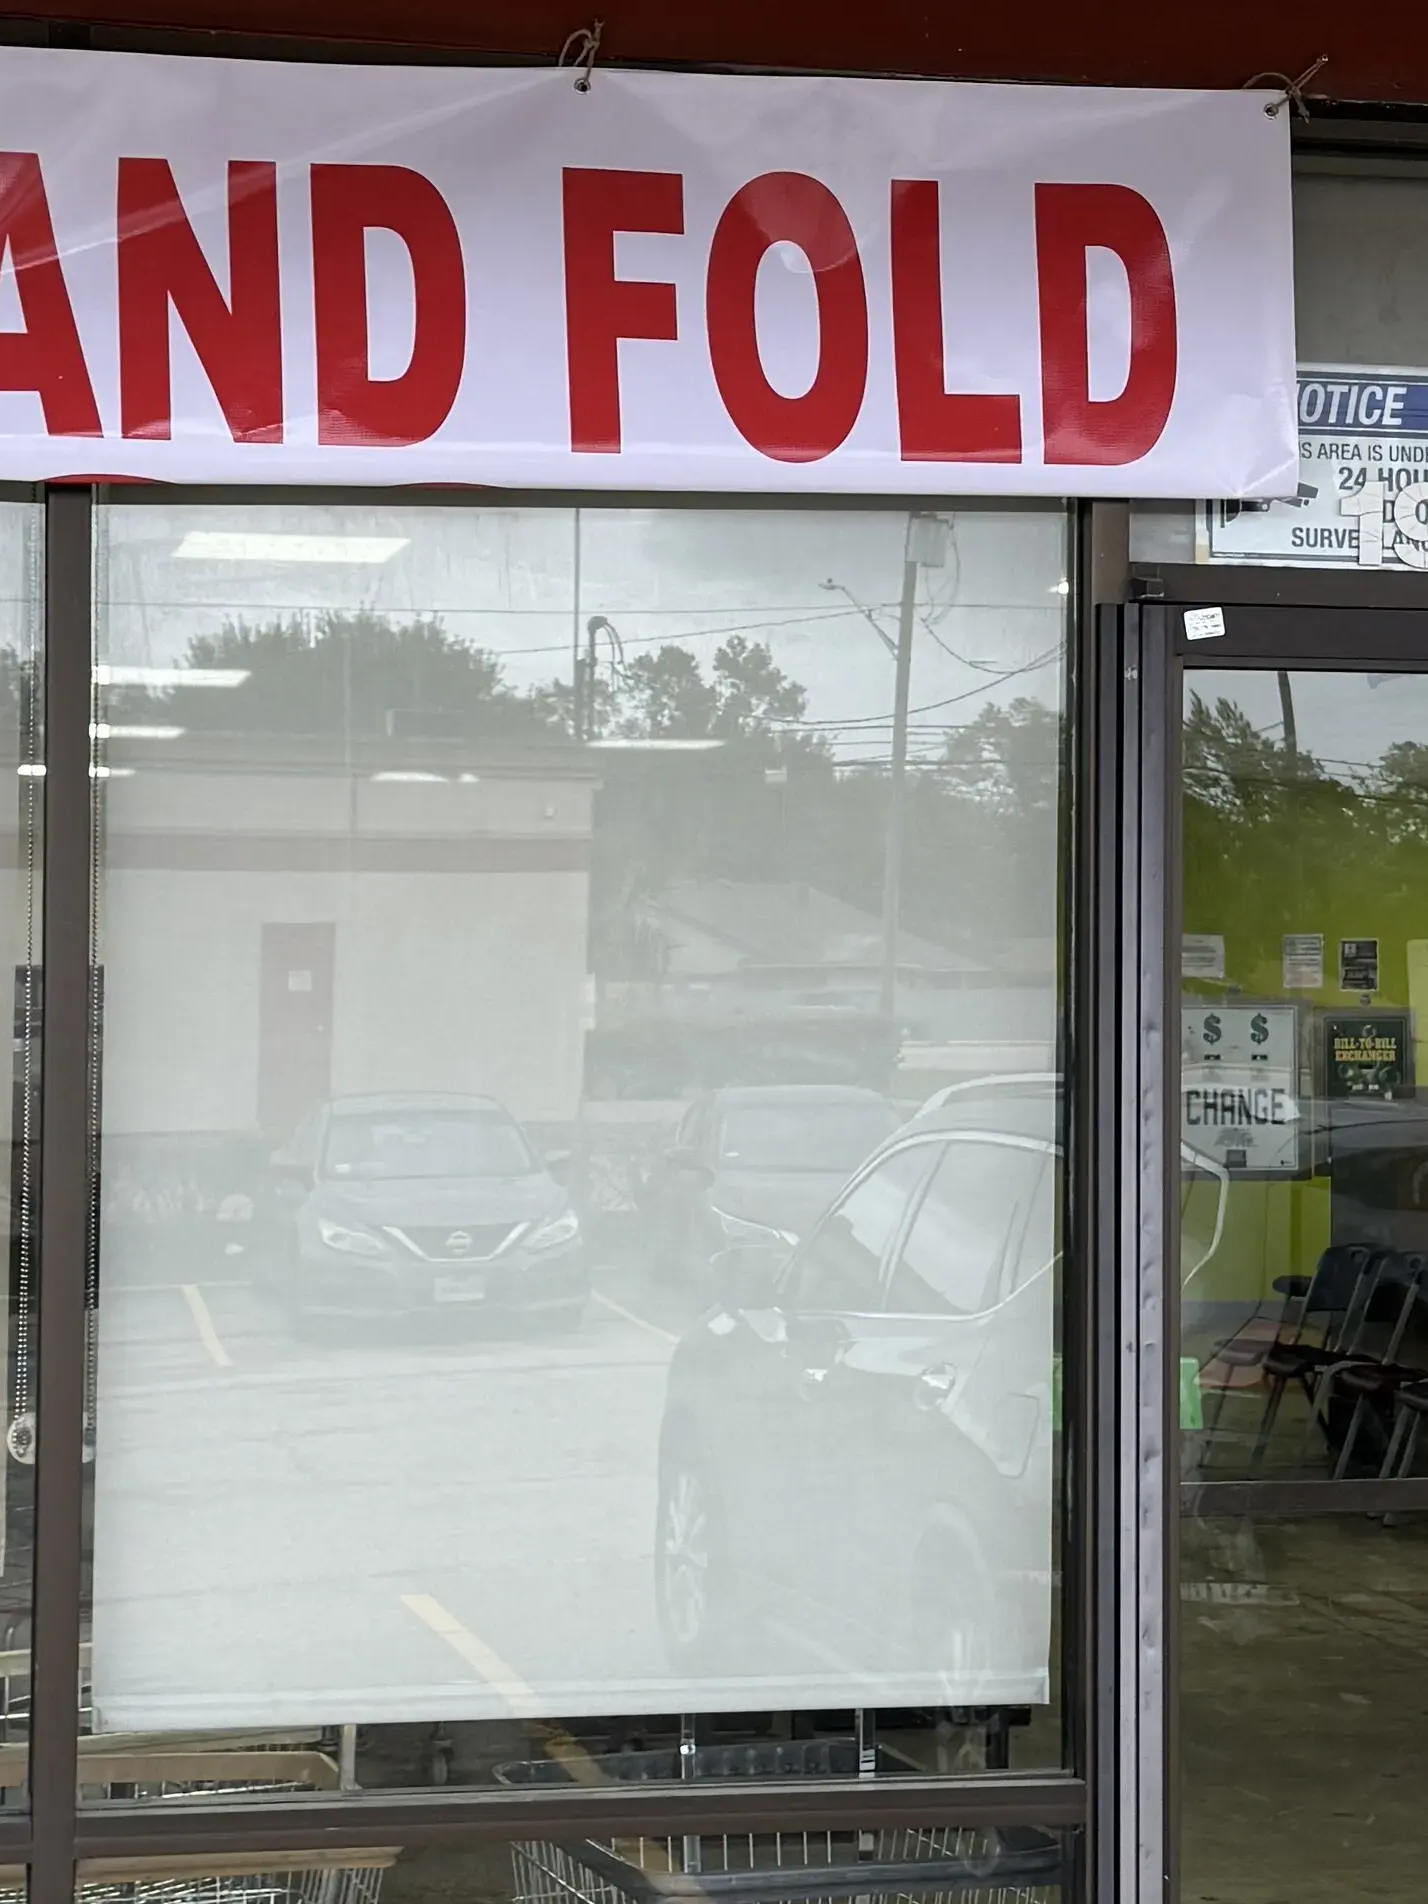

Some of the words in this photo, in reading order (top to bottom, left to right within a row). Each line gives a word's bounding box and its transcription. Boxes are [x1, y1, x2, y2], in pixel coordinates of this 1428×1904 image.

[562, 169, 1177, 467] FOLD
[1297, 383, 1408, 425] OTICE
[1317, 443, 1362, 461] AREA
[1368, 445, 1383, 461] IS
[1339, 467, 1367, 490] 24
[1186, 1088, 1286, 1125] CHANGE
